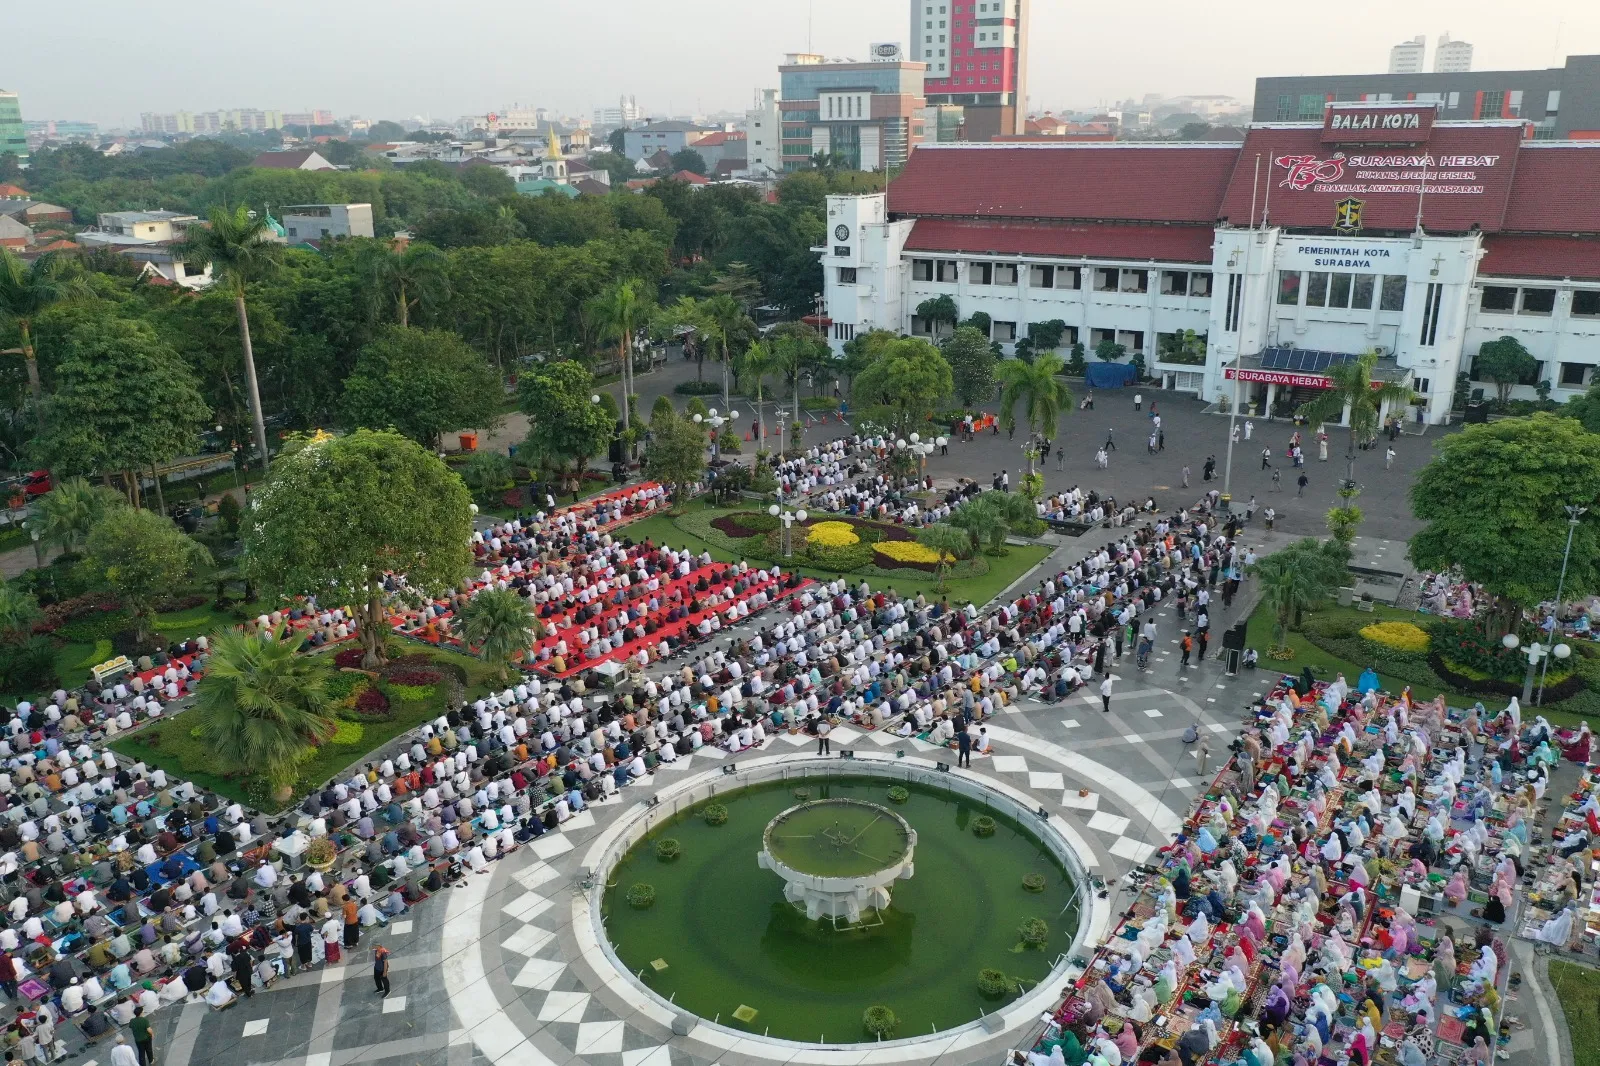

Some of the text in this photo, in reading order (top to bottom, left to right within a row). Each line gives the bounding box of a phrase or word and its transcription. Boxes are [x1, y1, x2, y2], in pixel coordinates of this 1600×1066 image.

[1331, 113, 1419, 130] BALAI KOTA
[1348, 156, 1500, 167] SURABAYA HEBAT
[1355, 170, 1399, 181] HUMANIS,
[1438, 171, 1476, 181] EFISIEN,
[1314, 184, 1367, 194] BERAKHLAK,
[1421, 184, 1484, 194] TRANSPARAN
[1298, 246, 1390, 257] PEMERINTAH KOTA
[1314, 258, 1370, 268] SURABAYA
[1238, 371, 1290, 384] SURABAYA
[1291, 376, 1324, 387] HEBAT
